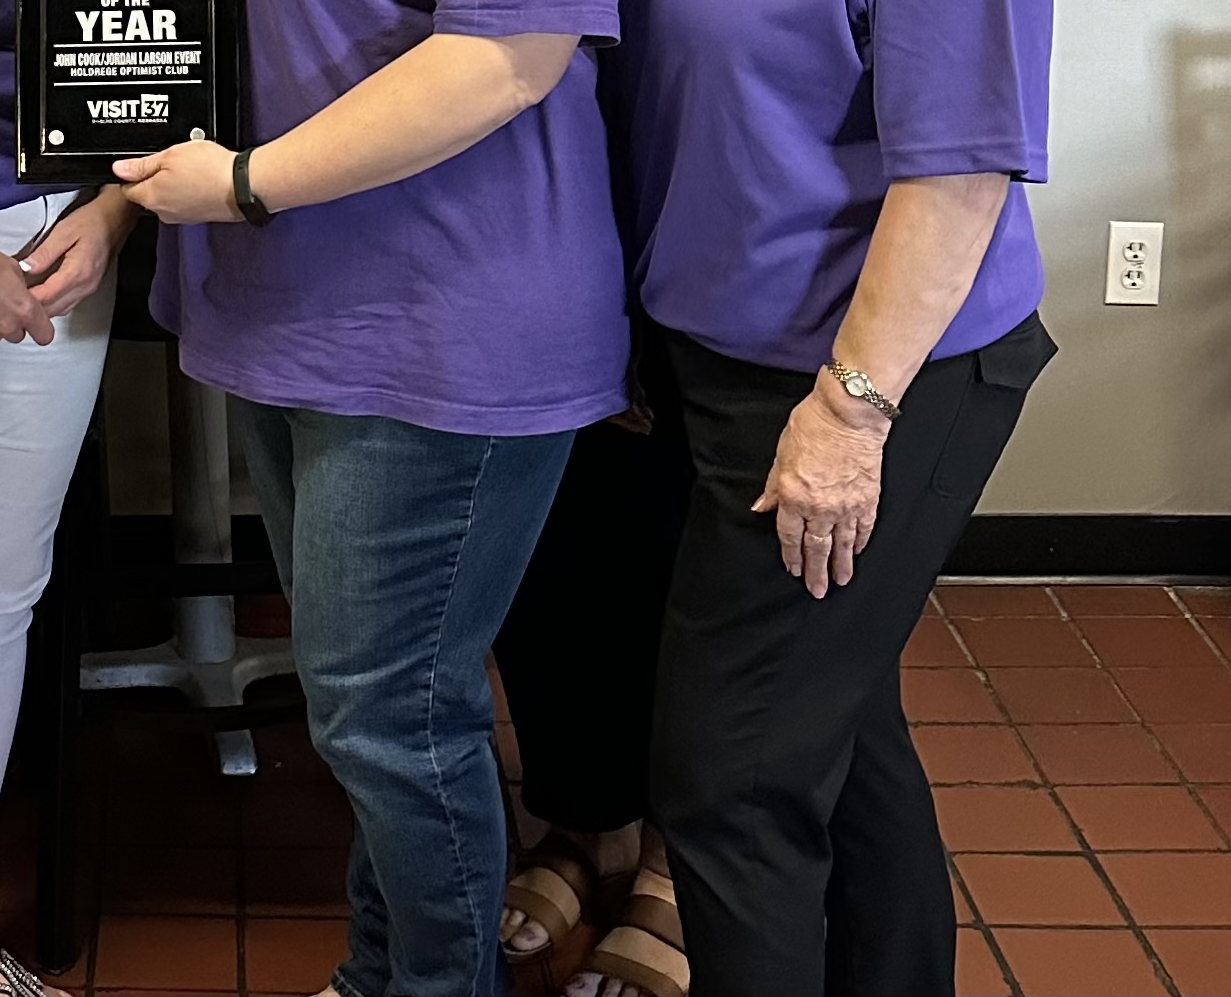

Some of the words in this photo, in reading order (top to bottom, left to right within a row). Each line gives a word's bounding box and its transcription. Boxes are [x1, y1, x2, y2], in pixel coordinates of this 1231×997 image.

[74, 9, 178, 42] YEAR
[53, 53, 77, 67] JOHN
[138, 51, 173, 65] LARSON
[174, 50, 202, 64] EVENT
[70, 66, 118, 77] HOLDREGE
[119, 65, 163, 76] OPTIMIST
[164, 65, 189, 75] CLUB
[86, 99, 141, 118] VISIT
